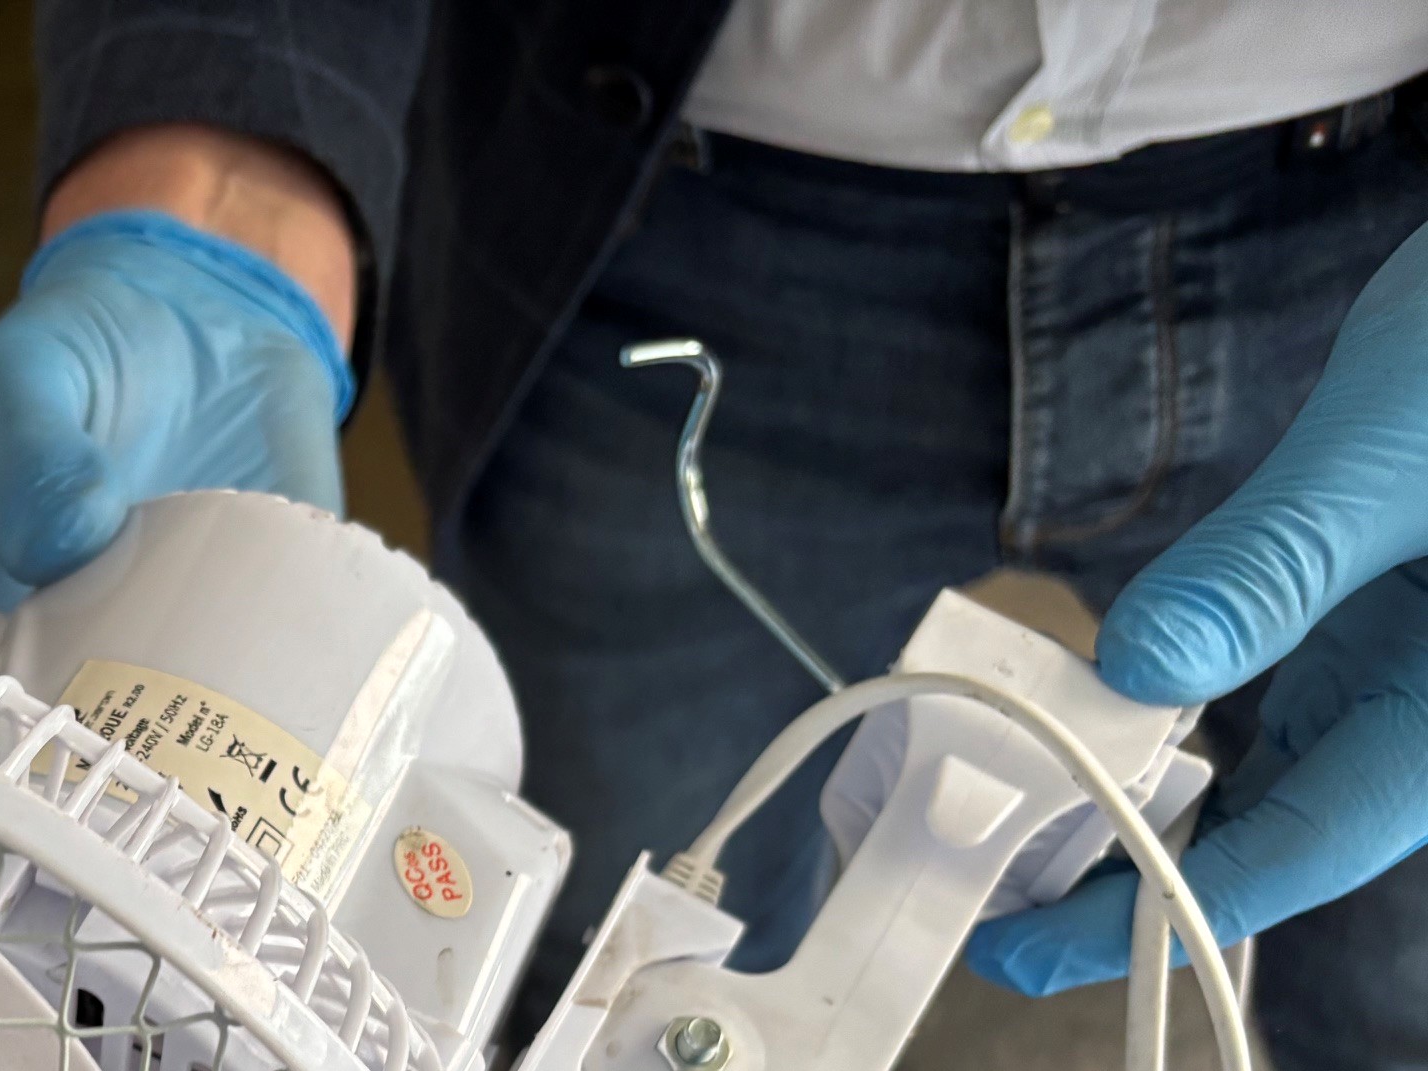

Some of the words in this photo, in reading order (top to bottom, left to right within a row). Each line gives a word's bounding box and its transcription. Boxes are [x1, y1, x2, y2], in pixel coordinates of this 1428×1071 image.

[160, 694, 188, 724] 50Hz
[176, 714, 205, 747] Model
[196, 712, 229, 753] LG-18A
[421, 842, 463, 902] PASS
